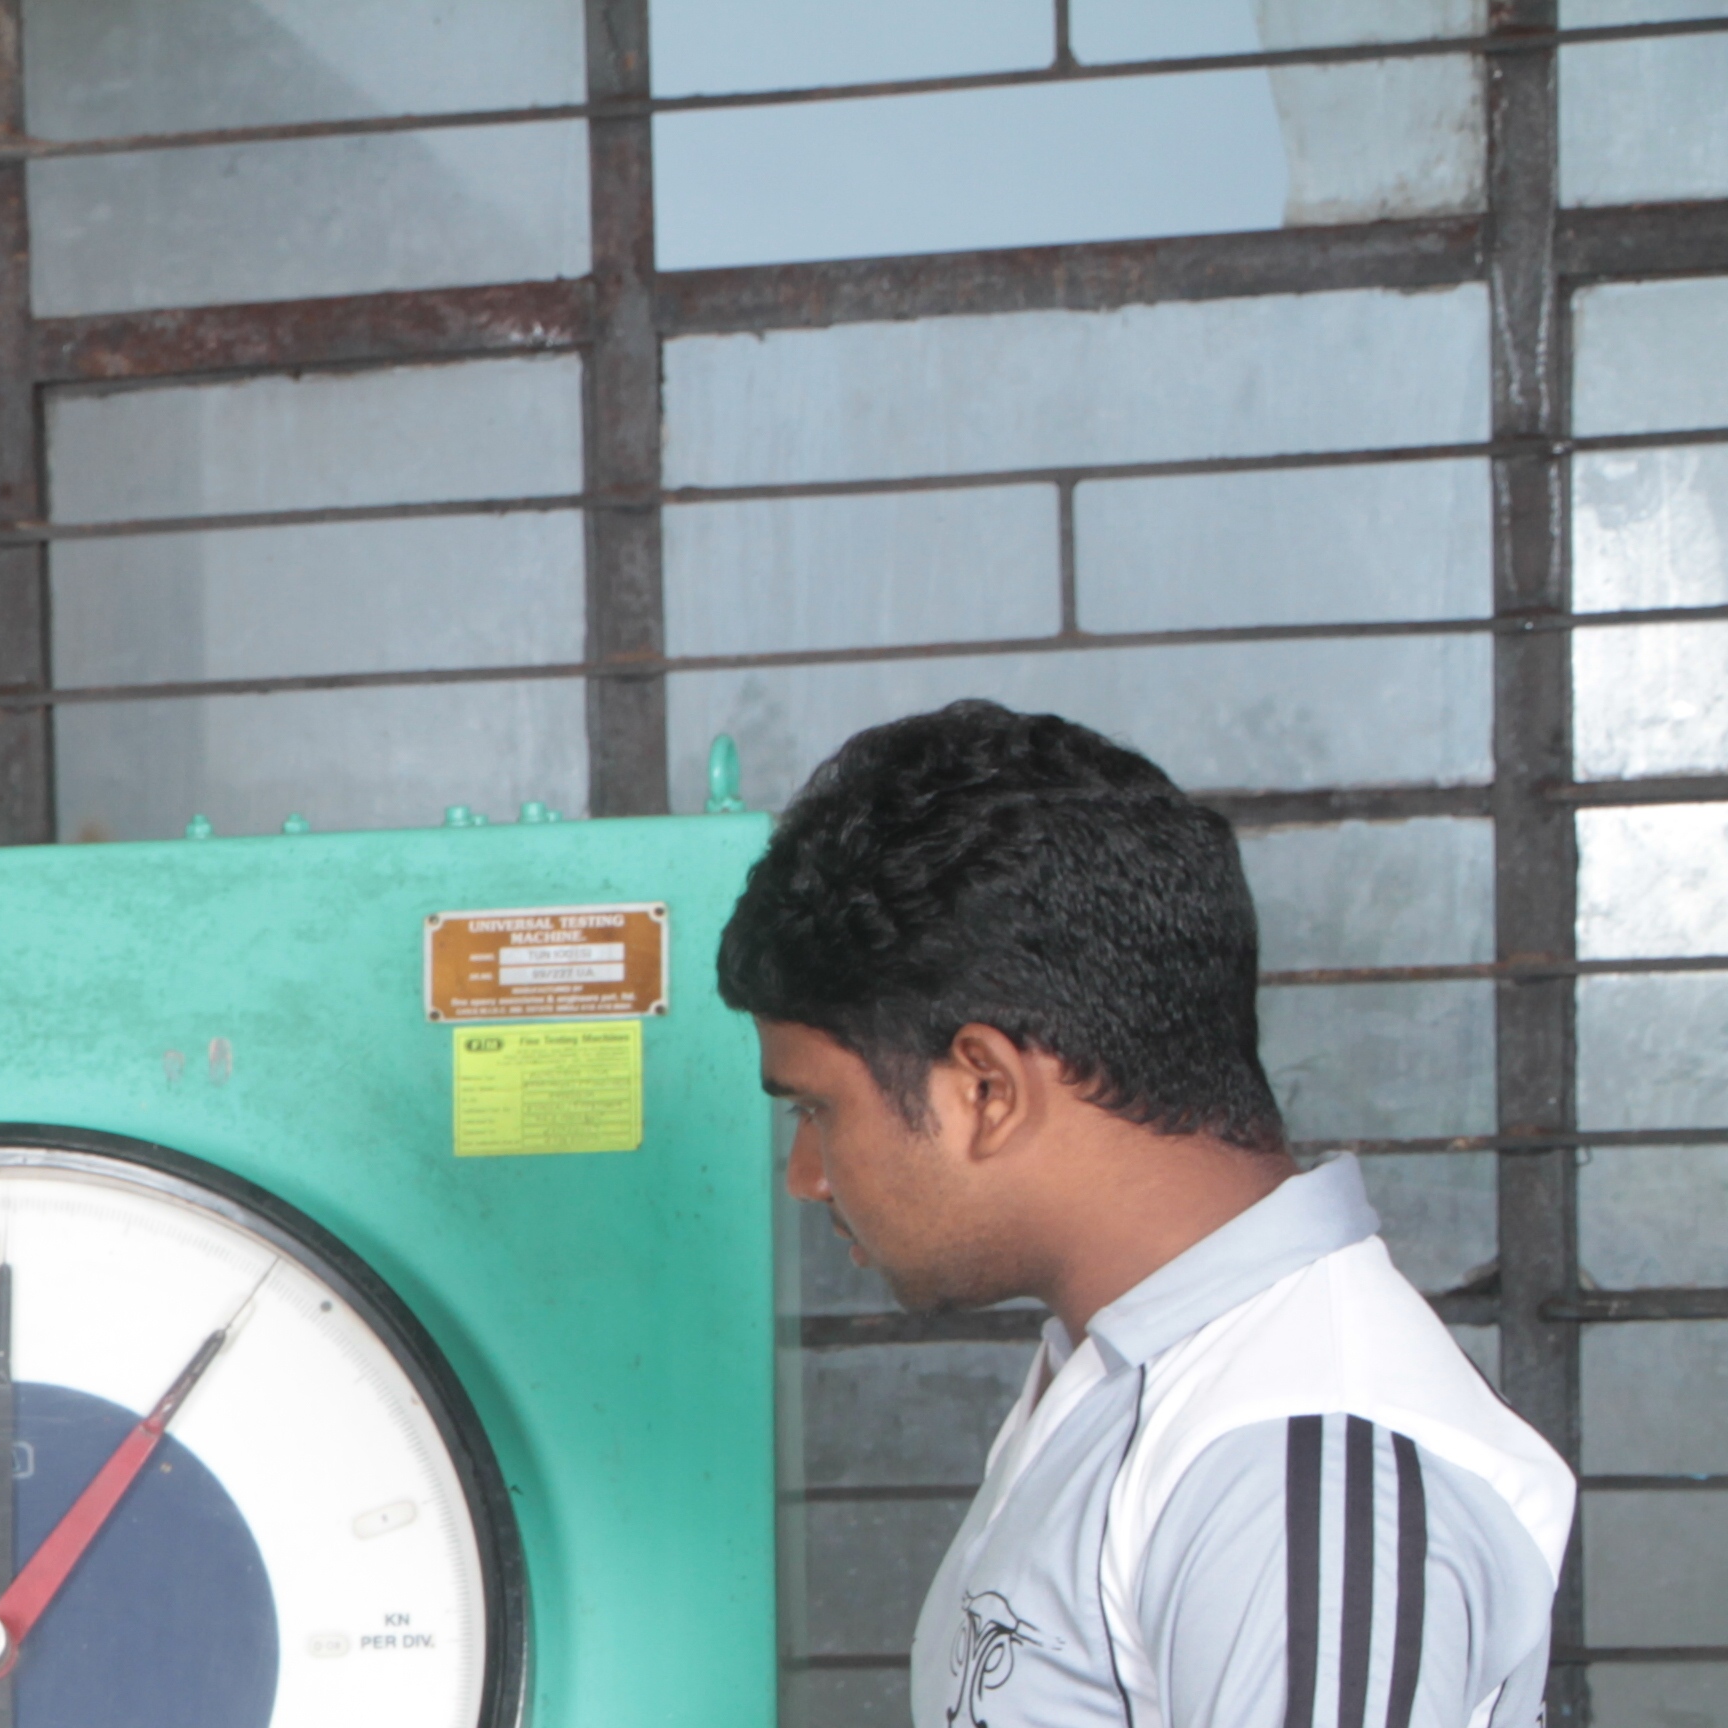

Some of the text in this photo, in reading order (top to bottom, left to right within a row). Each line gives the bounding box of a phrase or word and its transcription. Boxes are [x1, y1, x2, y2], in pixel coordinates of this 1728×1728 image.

[467, 914, 625, 932] UNIVERSAL TESTING
[384, 1613, 410, 1627] KN
[360, 1634, 397, 1649] PER
[402, 1633, 436, 1649] DIV.
